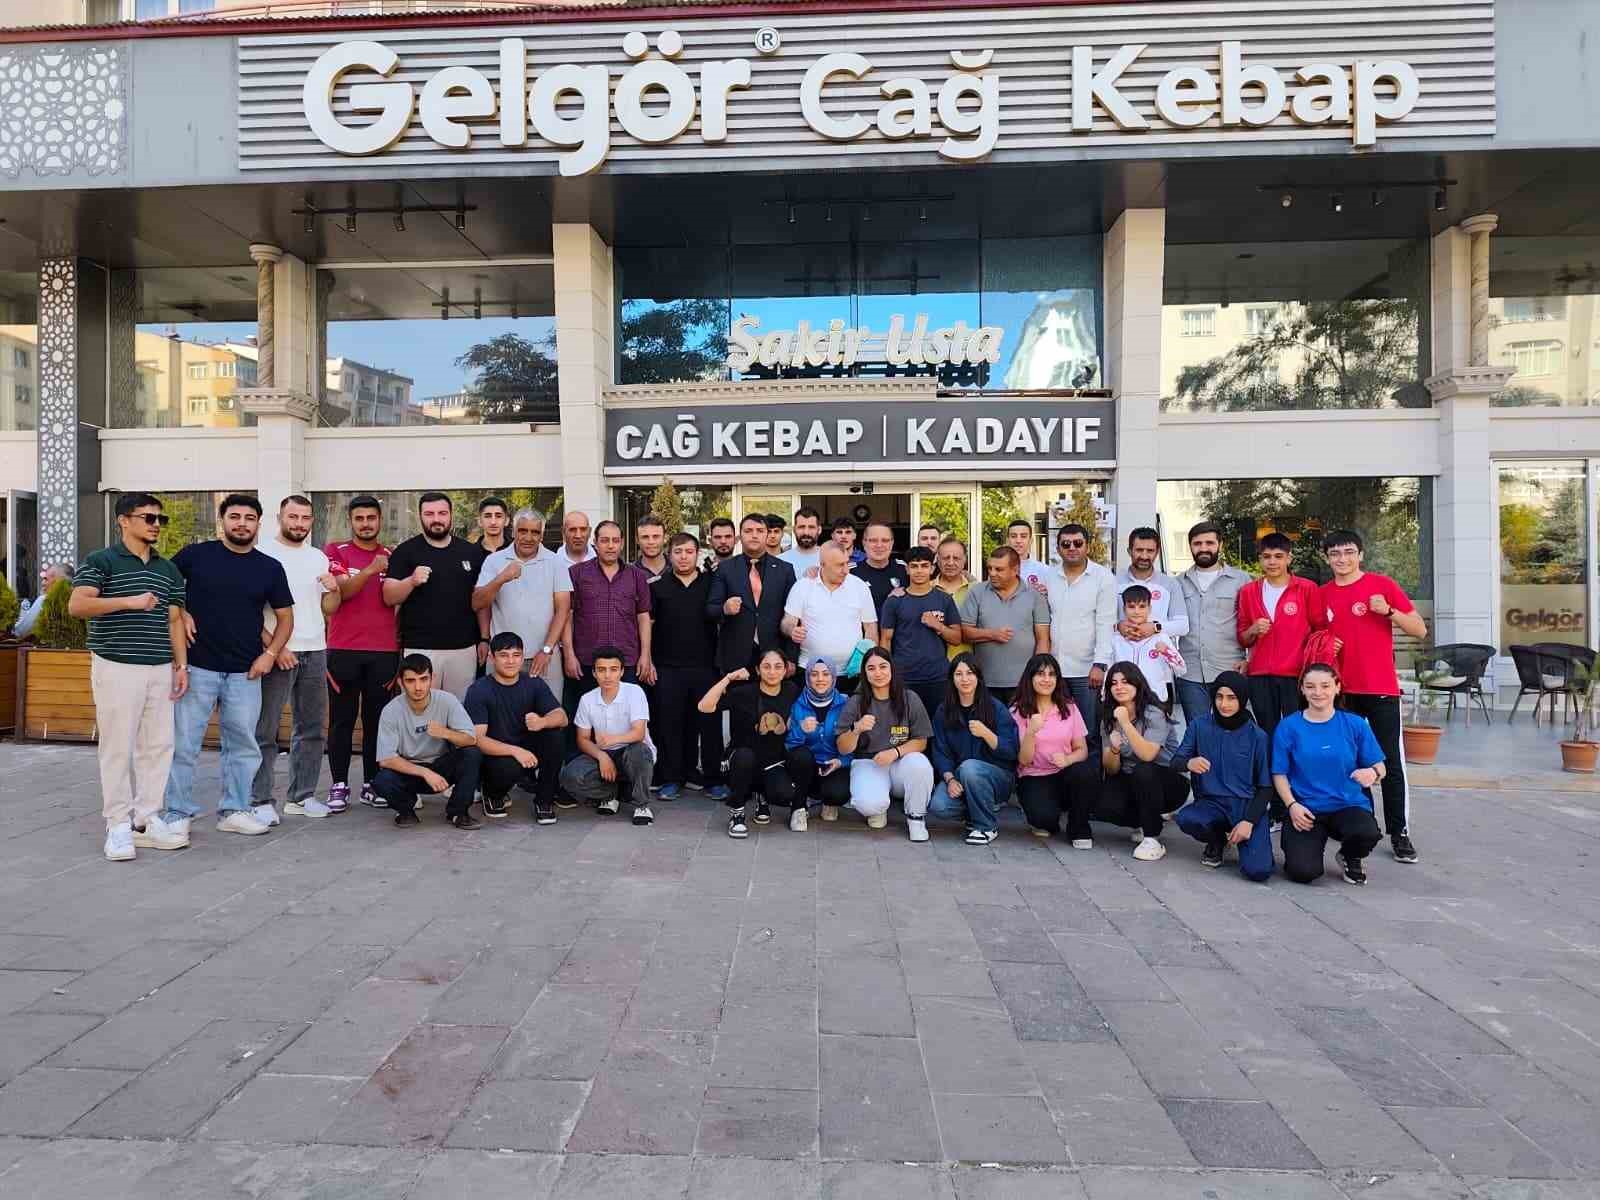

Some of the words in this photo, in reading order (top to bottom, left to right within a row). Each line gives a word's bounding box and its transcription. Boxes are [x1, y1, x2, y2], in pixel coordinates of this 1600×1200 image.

[303, 30, 752, 177] Gelgör
[799, 48, 1000, 162] Cağ
[1071, 40, 1421, 148] Kebap
[886, 312, 1004, 365] Usta
[615, 413, 701, 460] CAĞ
[711, 418, 864, 459] KEBAP
[906, 416, 1101, 455] KADAYIF
